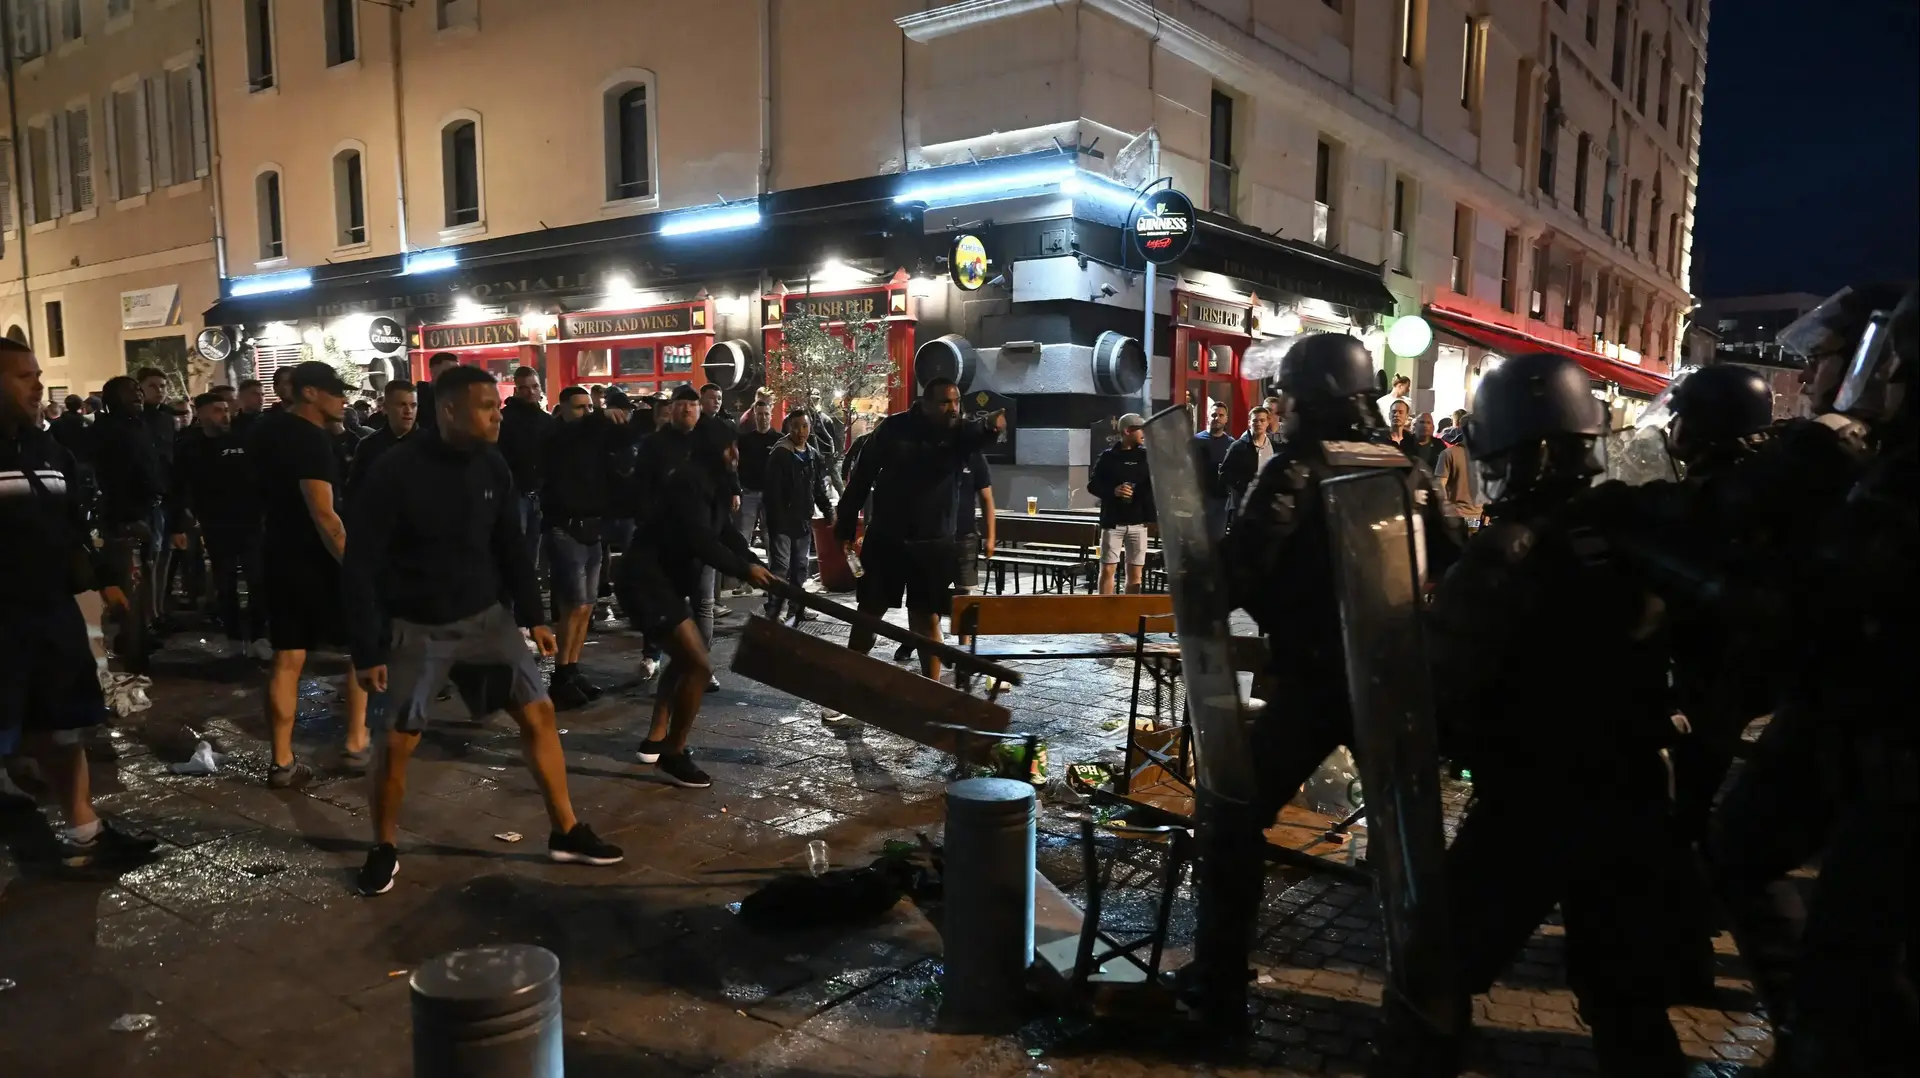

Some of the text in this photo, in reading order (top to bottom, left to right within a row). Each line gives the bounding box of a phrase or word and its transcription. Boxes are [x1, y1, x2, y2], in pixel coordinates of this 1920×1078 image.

[1136, 217, 1187, 231] GUINNESS
[803, 300, 843, 316] RISH
[1199, 306, 1223, 324] IRISH
[573, 314, 679, 335] SPIRITS AND WINES
[430, 324, 515, 347] O'MALLEY'S
